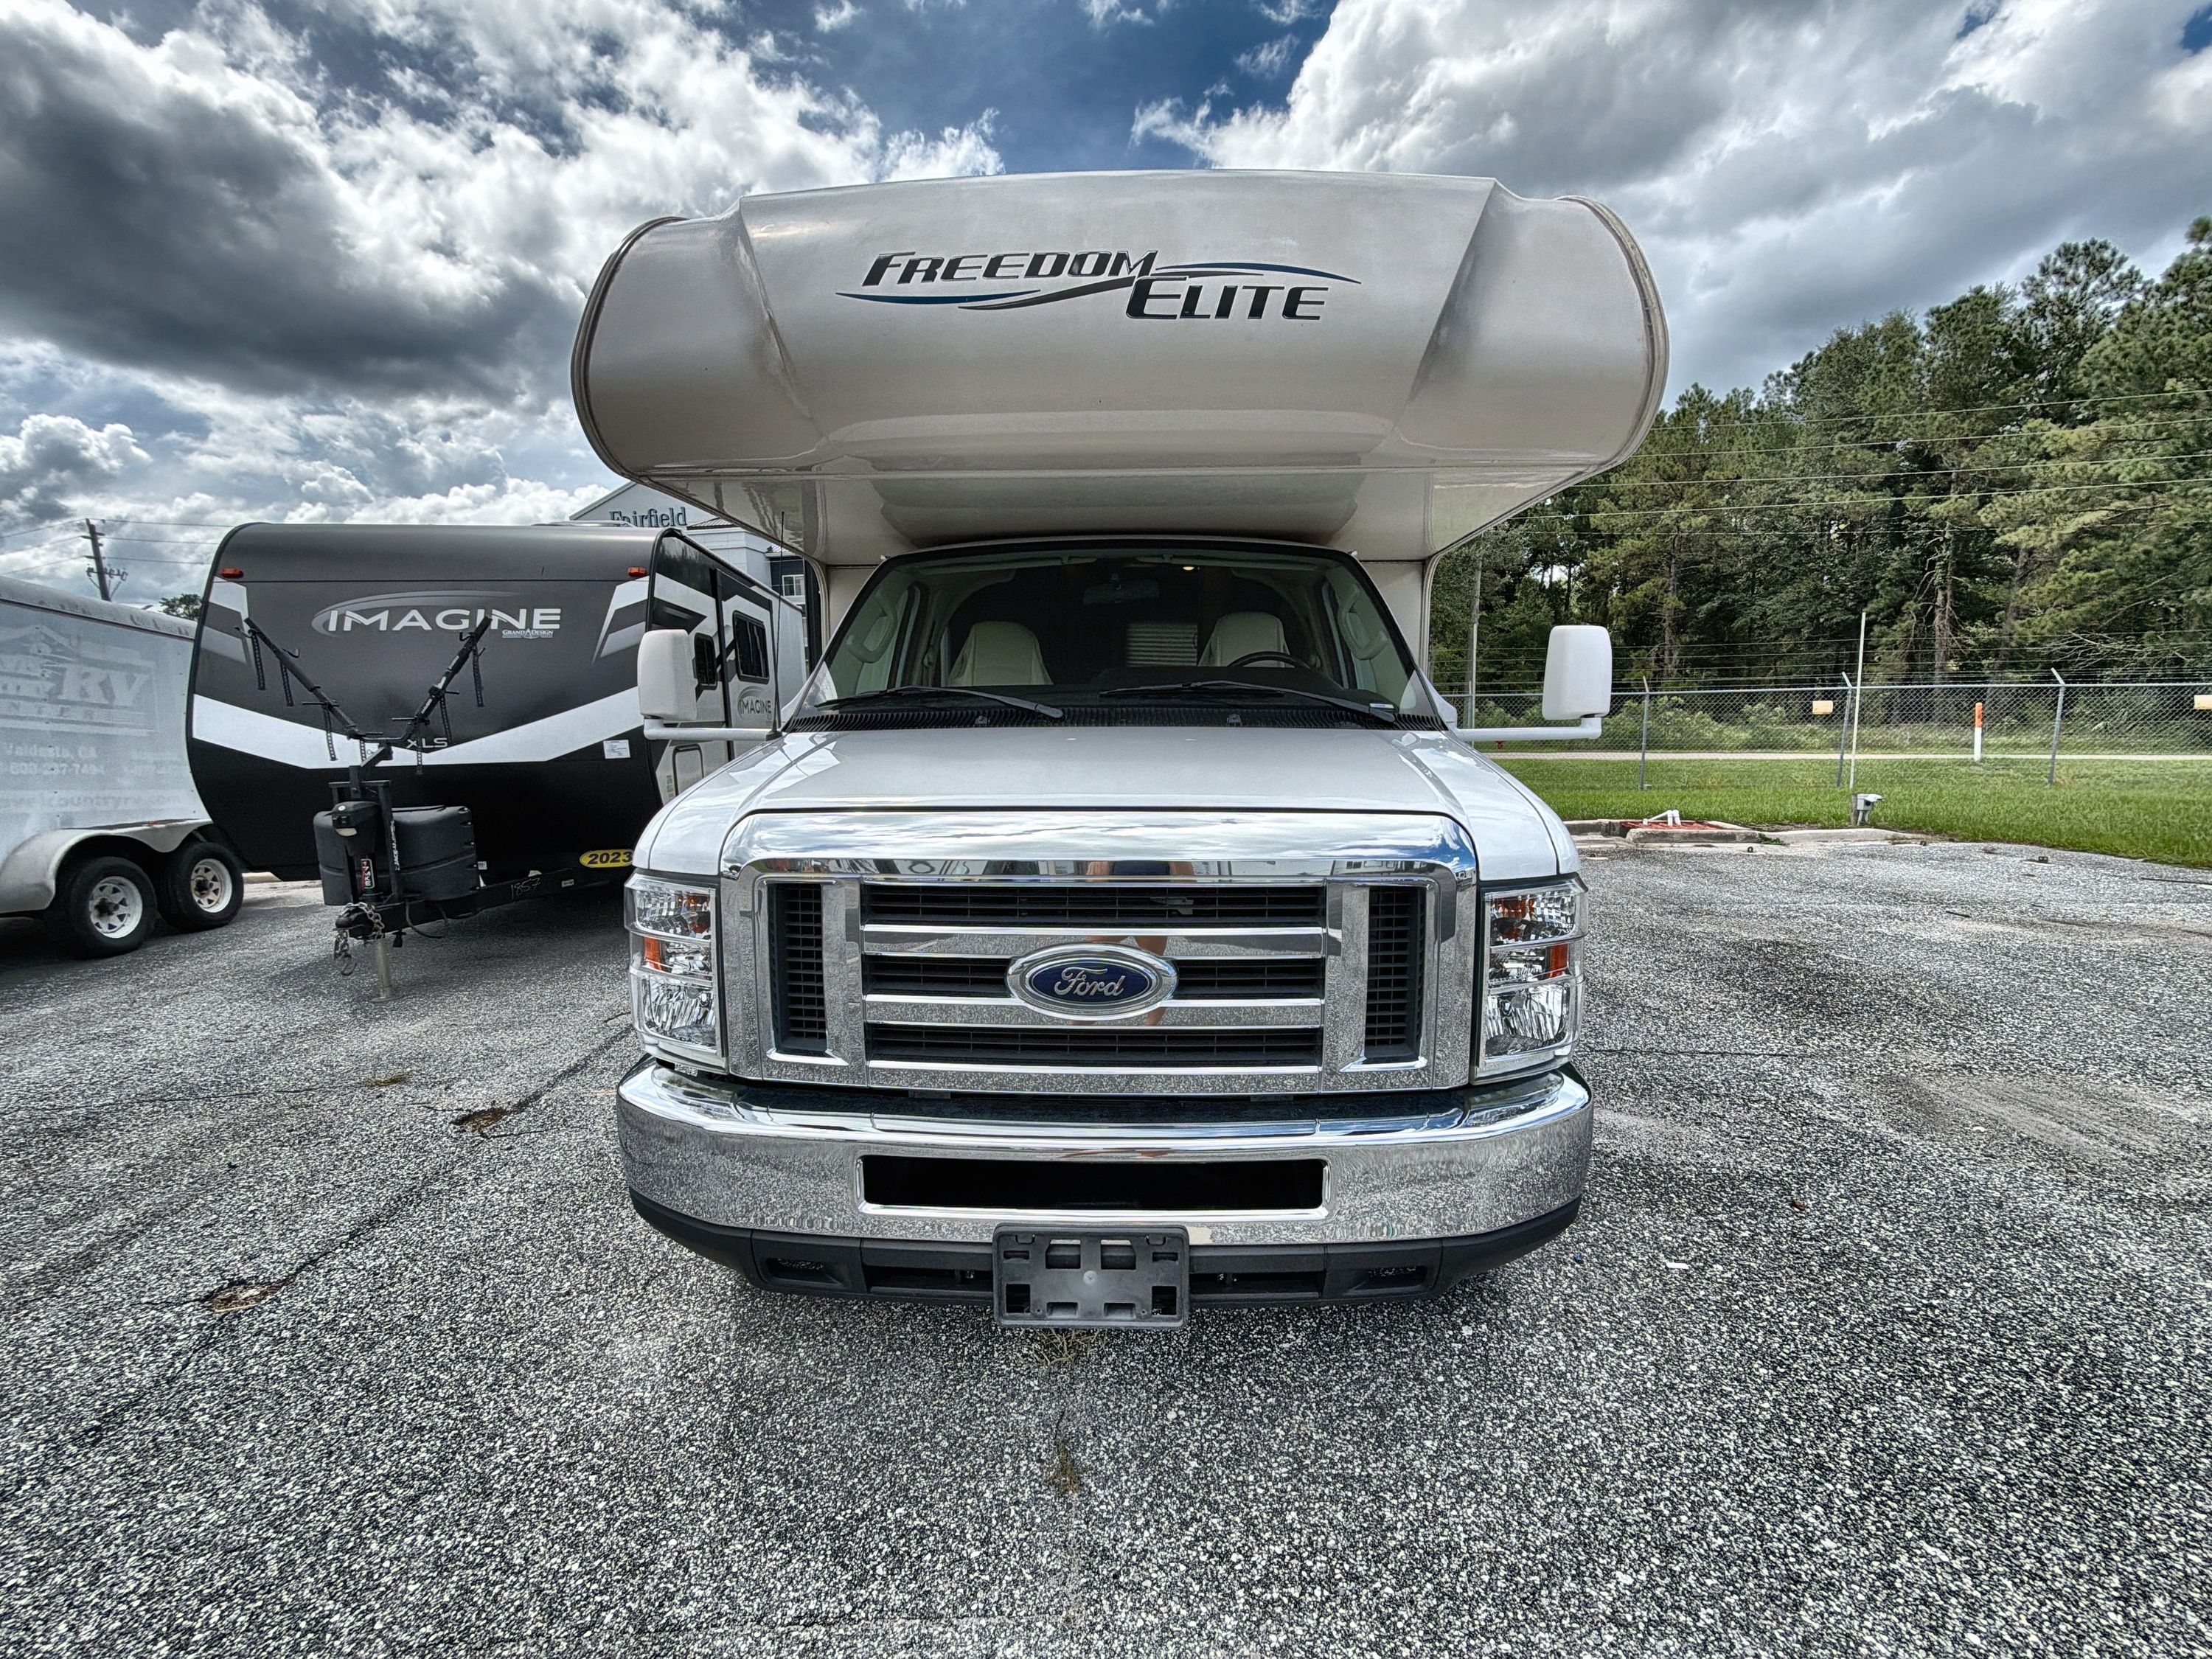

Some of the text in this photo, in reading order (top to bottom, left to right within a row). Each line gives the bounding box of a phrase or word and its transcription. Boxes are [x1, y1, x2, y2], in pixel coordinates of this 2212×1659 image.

[862, 250, 1158, 287] FREEDOM
[1126, 276, 1329, 319] ELITE
[328, 608, 561, 631] IMAGINE
[738, 699, 772, 714] IMAGINE
[588, 852, 633, 864] 2023
[1054, 967, 1125, 996] Ford
